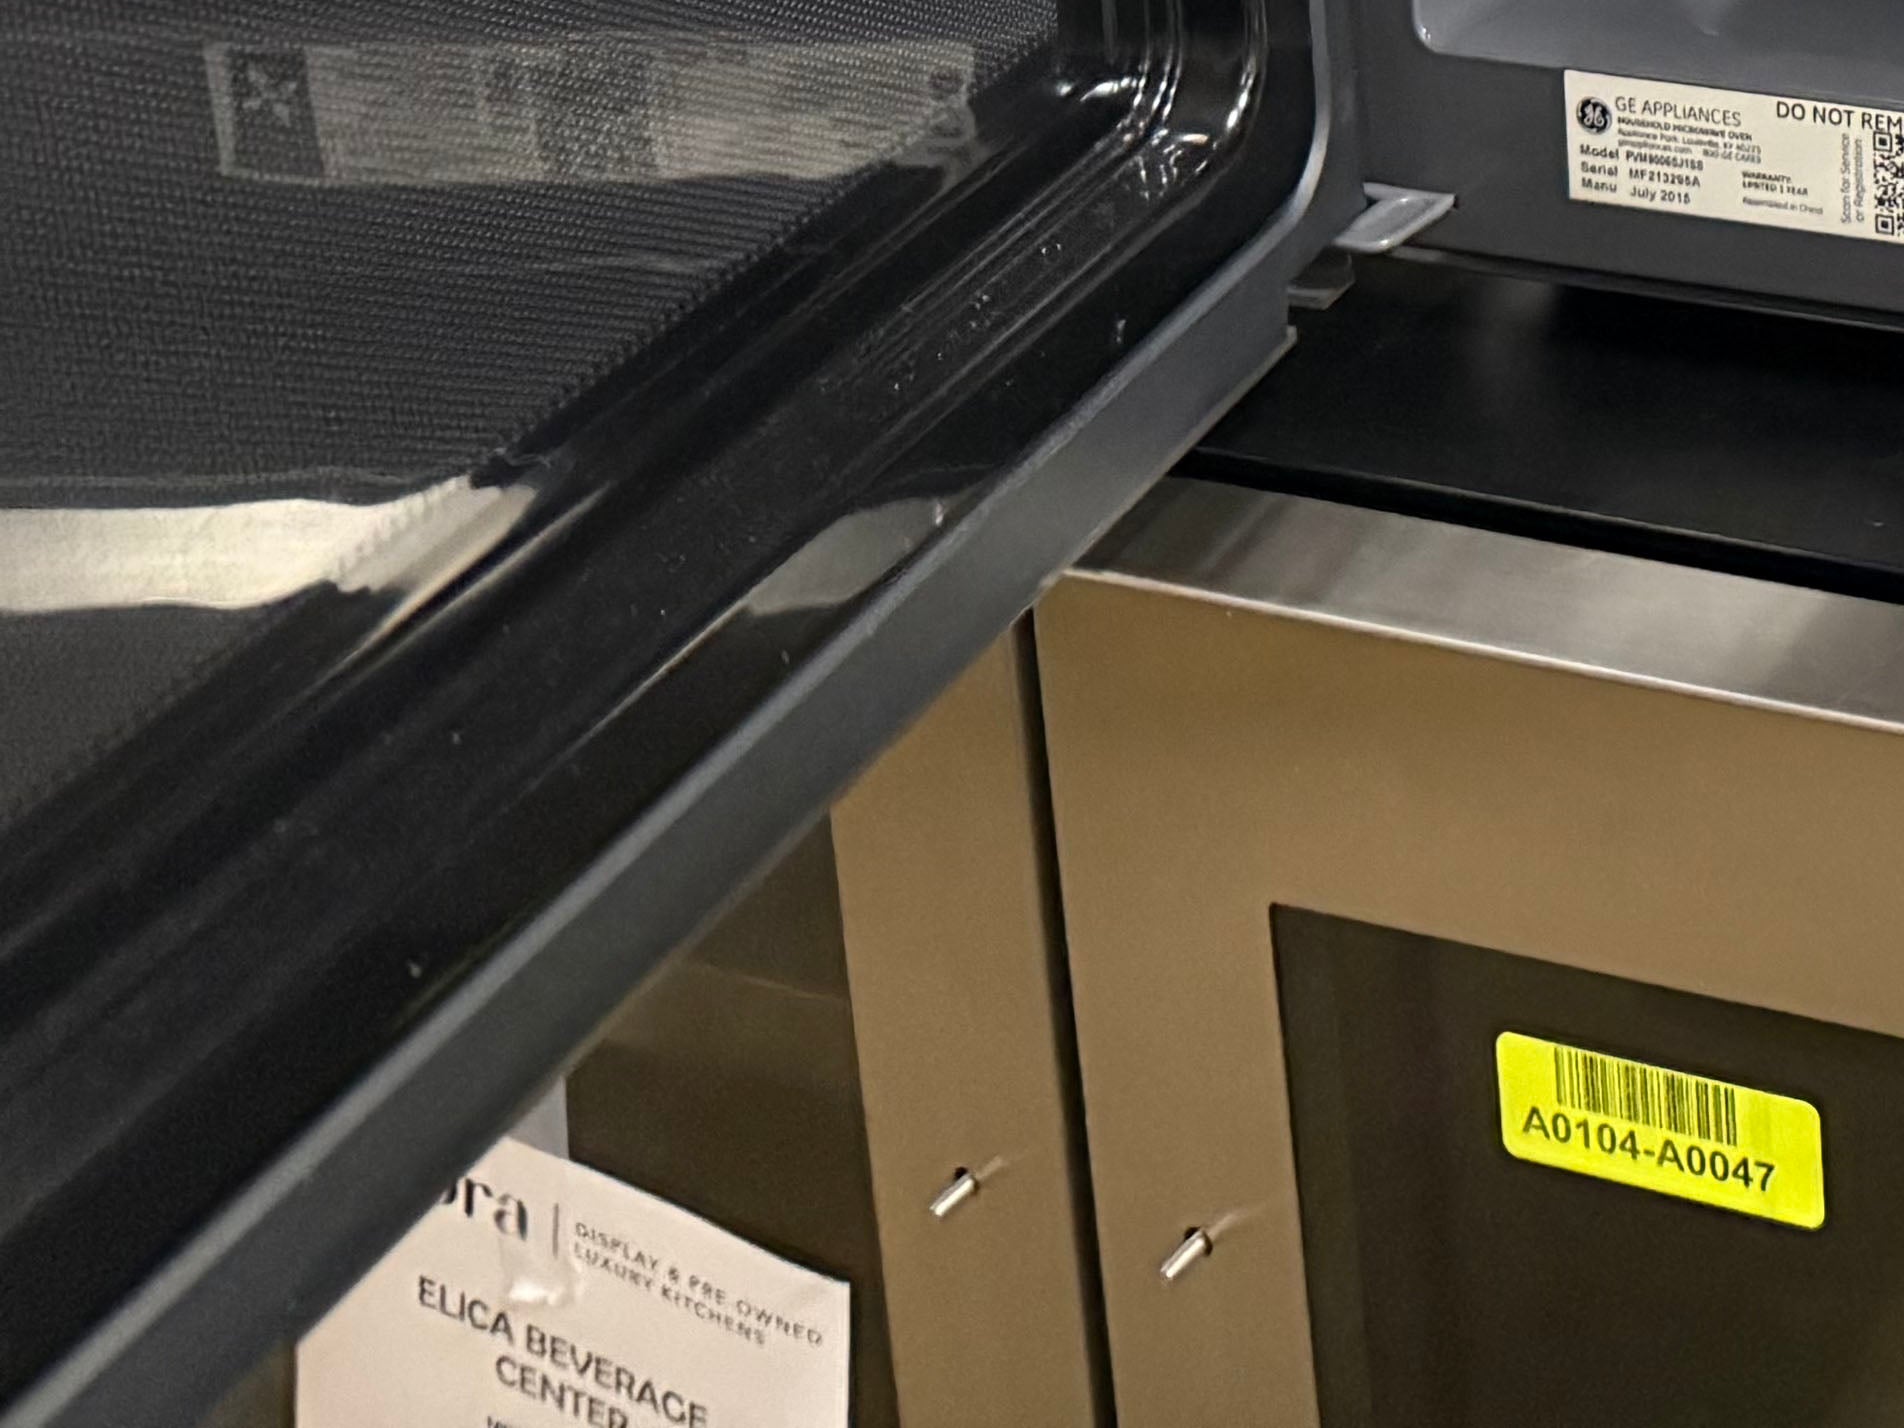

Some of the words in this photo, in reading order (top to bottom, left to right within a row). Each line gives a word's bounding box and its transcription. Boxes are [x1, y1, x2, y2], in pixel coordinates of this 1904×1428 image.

[1615, 96, 1636, 113] GE
[1642, 100, 1742, 127] APPLIANCES
[1777, 101, 1805, 121] DO
[1813, 105, 1854, 128] NOT
[1580, 144, 1619, 159] Model
[1728, 131, 1752, 142] OVEN
[1581, 161, 1618, 176] Serial
[1582, 178, 1617, 193] Manu
[1631, 186, 1656, 202] July
[1521, 1105, 1776, 1194] A0104-A0047
[574, 1242, 653, 1291] LUXURY
[660, 1284, 766, 1345] KITCHENS
[575, 1221, 659, 1271] DISPLAY
[668, 1266, 680, 1282] &
[689, 1274, 727, 1305] PRE
[736, 1299, 823, 1346] OWNED
[416, 1274, 515, 1342] ELICA
[523, 1323, 709, 1428] BEVERAGE
[494, 1355, 630, 1428] CENTER
